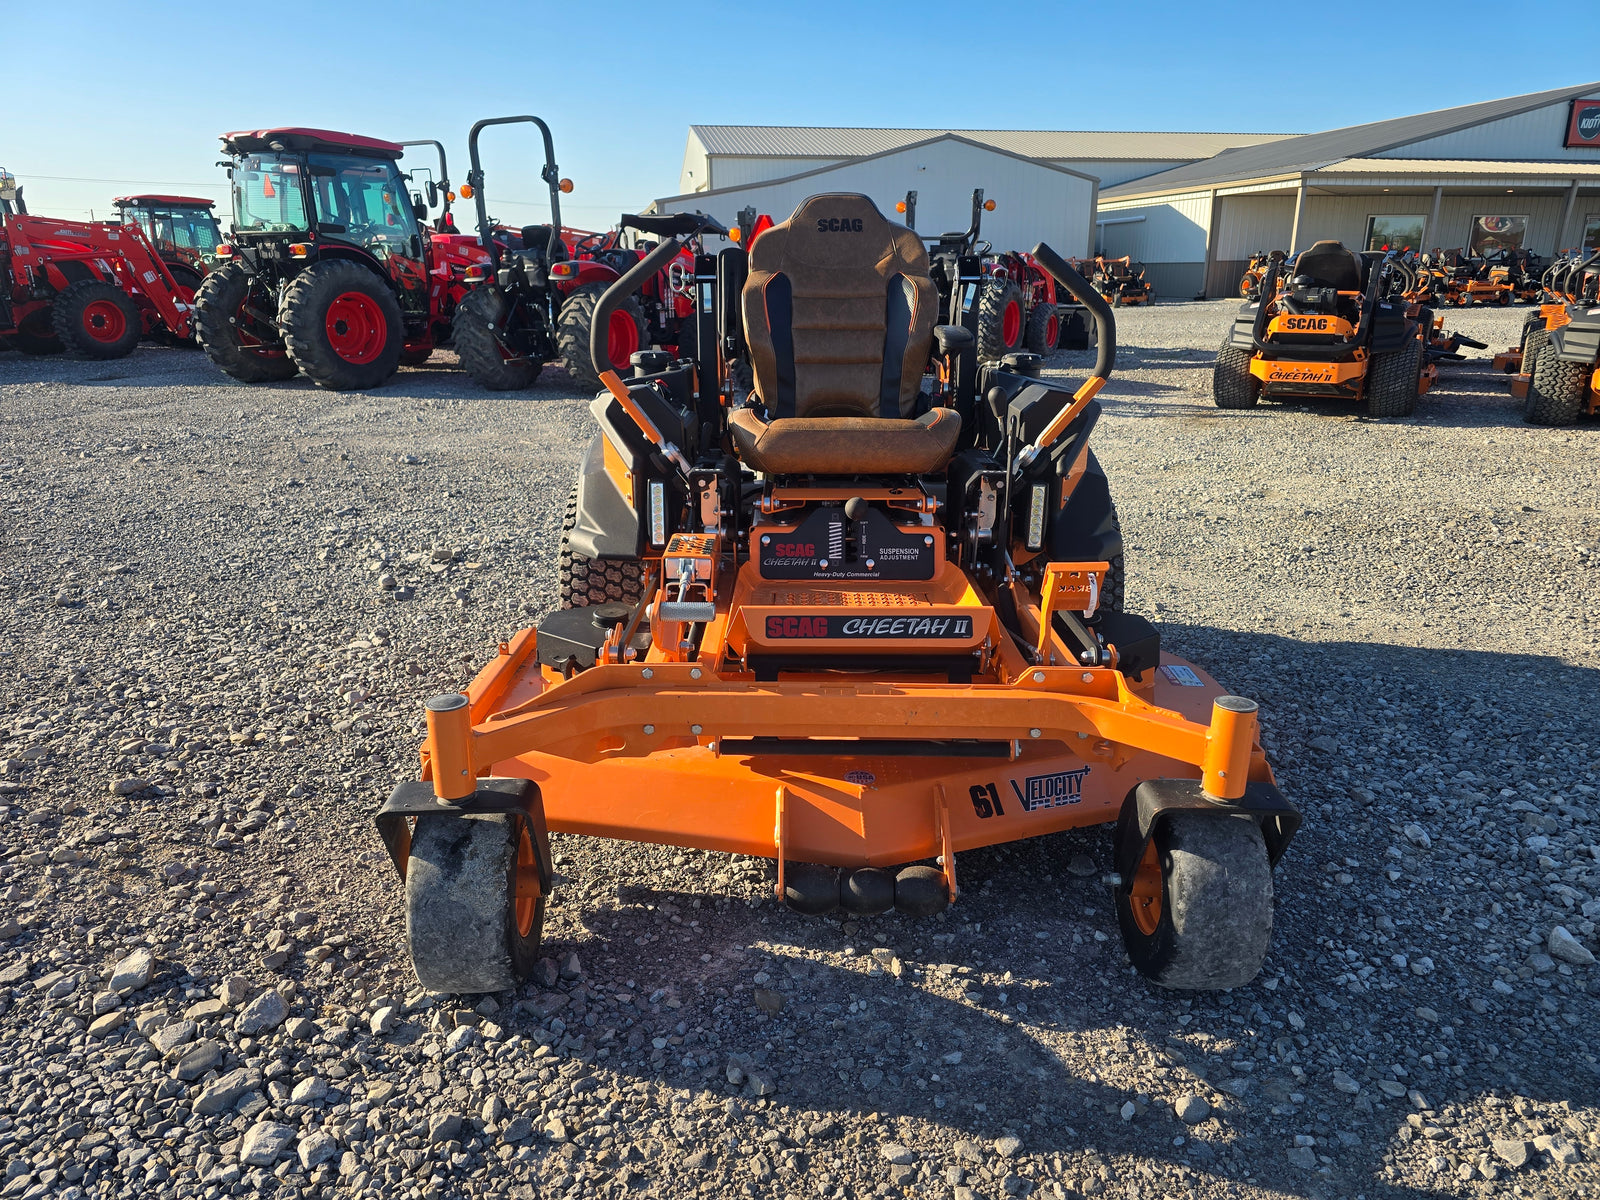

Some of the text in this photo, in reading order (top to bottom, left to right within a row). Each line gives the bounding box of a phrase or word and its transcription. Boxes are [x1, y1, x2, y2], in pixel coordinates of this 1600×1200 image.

[817, 218, 863, 232] SCAG
[1287, 318, 1328, 330] SCAG
[1269, 371, 1323, 381] CHEETAH
[775, 543, 815, 557] SCAG
[763, 557, 810, 567] CHEETAH
[767, 617, 828, 637] SCAG
[842, 618, 950, 636] CHEETAH
[969, 782, 1005, 819] 61
[1031, 794, 1082, 811] PLUS
